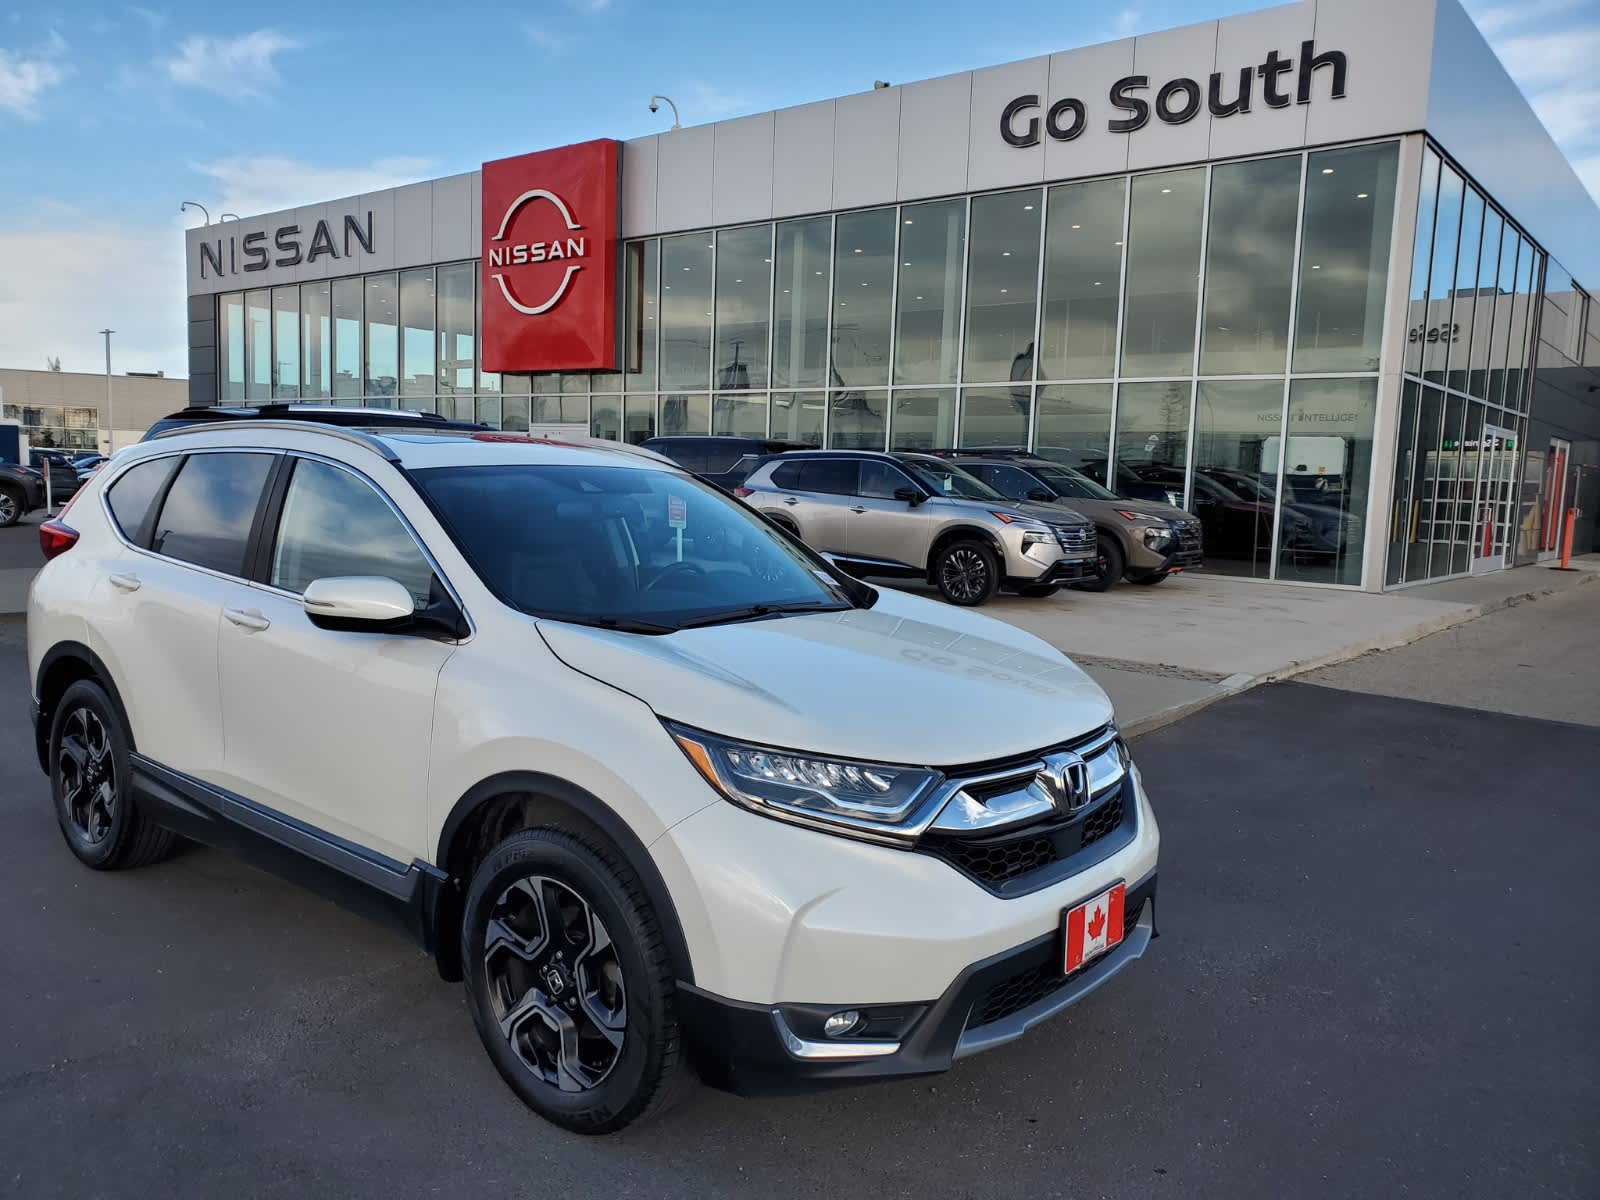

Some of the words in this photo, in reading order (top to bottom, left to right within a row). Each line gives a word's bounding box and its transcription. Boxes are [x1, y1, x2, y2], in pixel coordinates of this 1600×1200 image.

[999, 94, 1087, 148] Go
[1107, 40, 1349, 133] South
[199, 209, 376, 279] NISSAN
[488, 237, 585, 267] NISSAN
